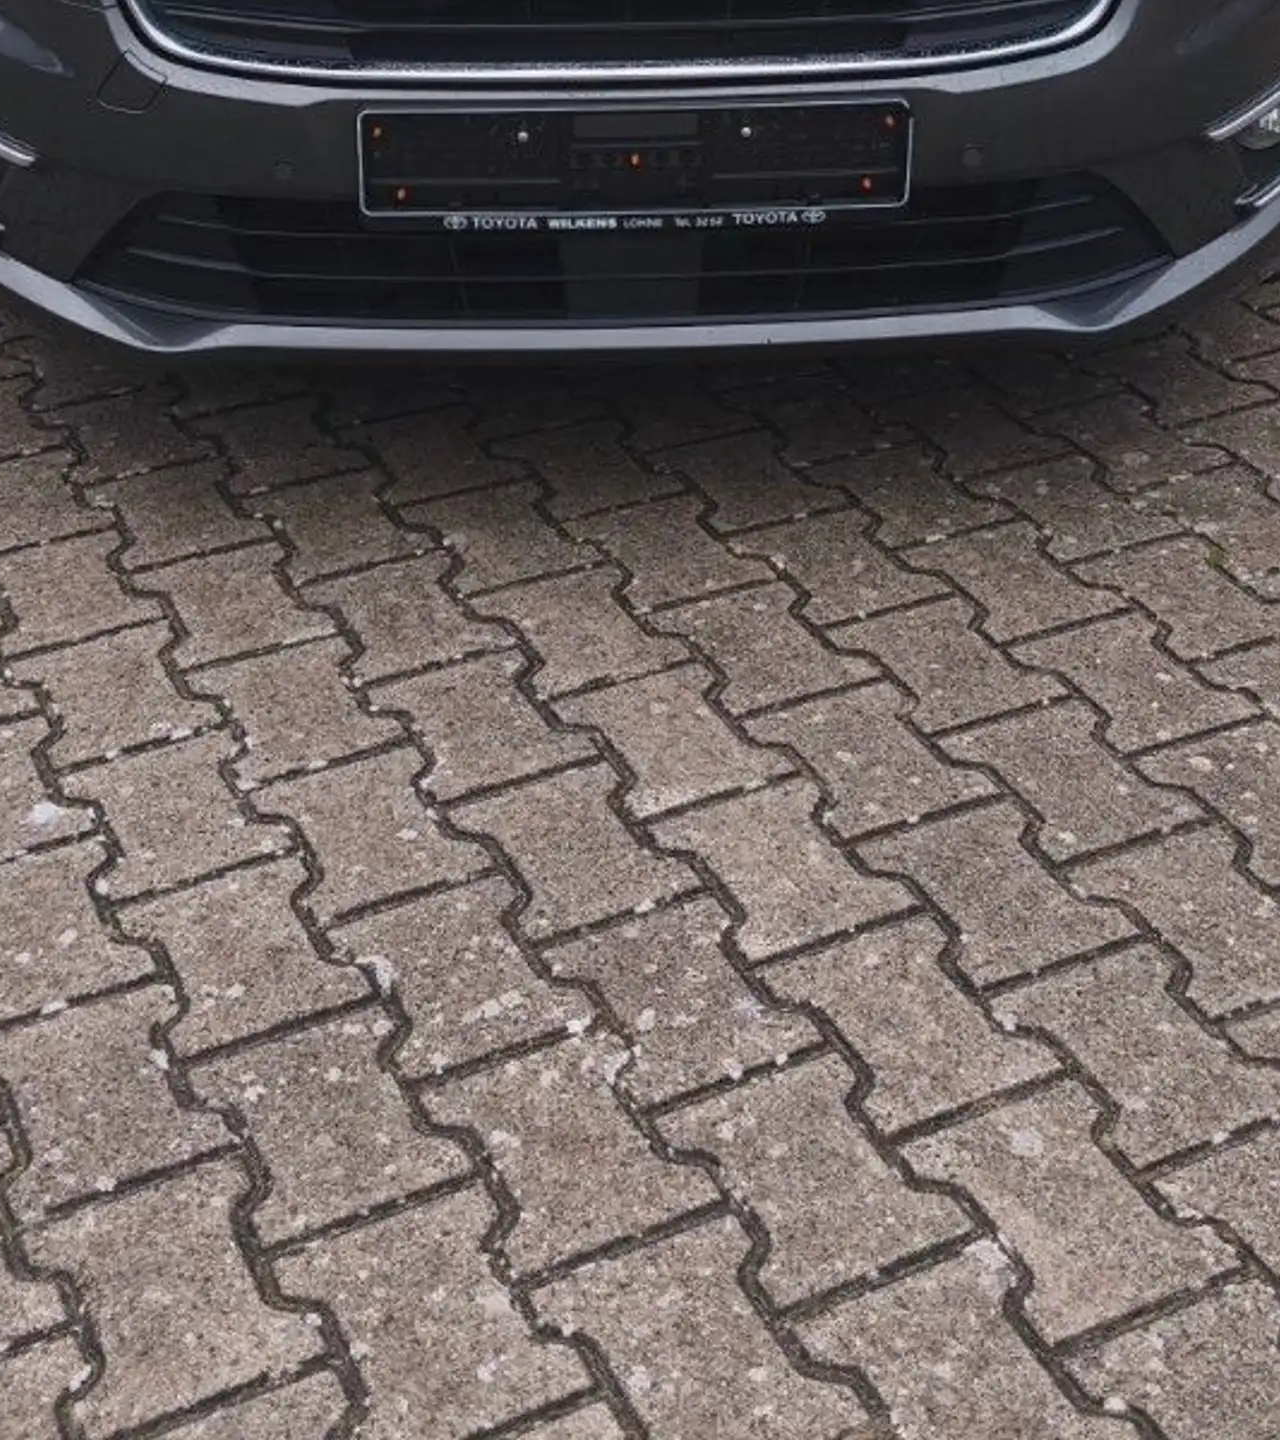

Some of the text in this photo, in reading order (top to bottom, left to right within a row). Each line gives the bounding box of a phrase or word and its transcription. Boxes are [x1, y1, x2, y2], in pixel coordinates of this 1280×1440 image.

[472, 216, 538, 230] TOYOTA
[547, 216, 618, 230] WILKENS
[731, 211, 798, 225] TOYOTA
